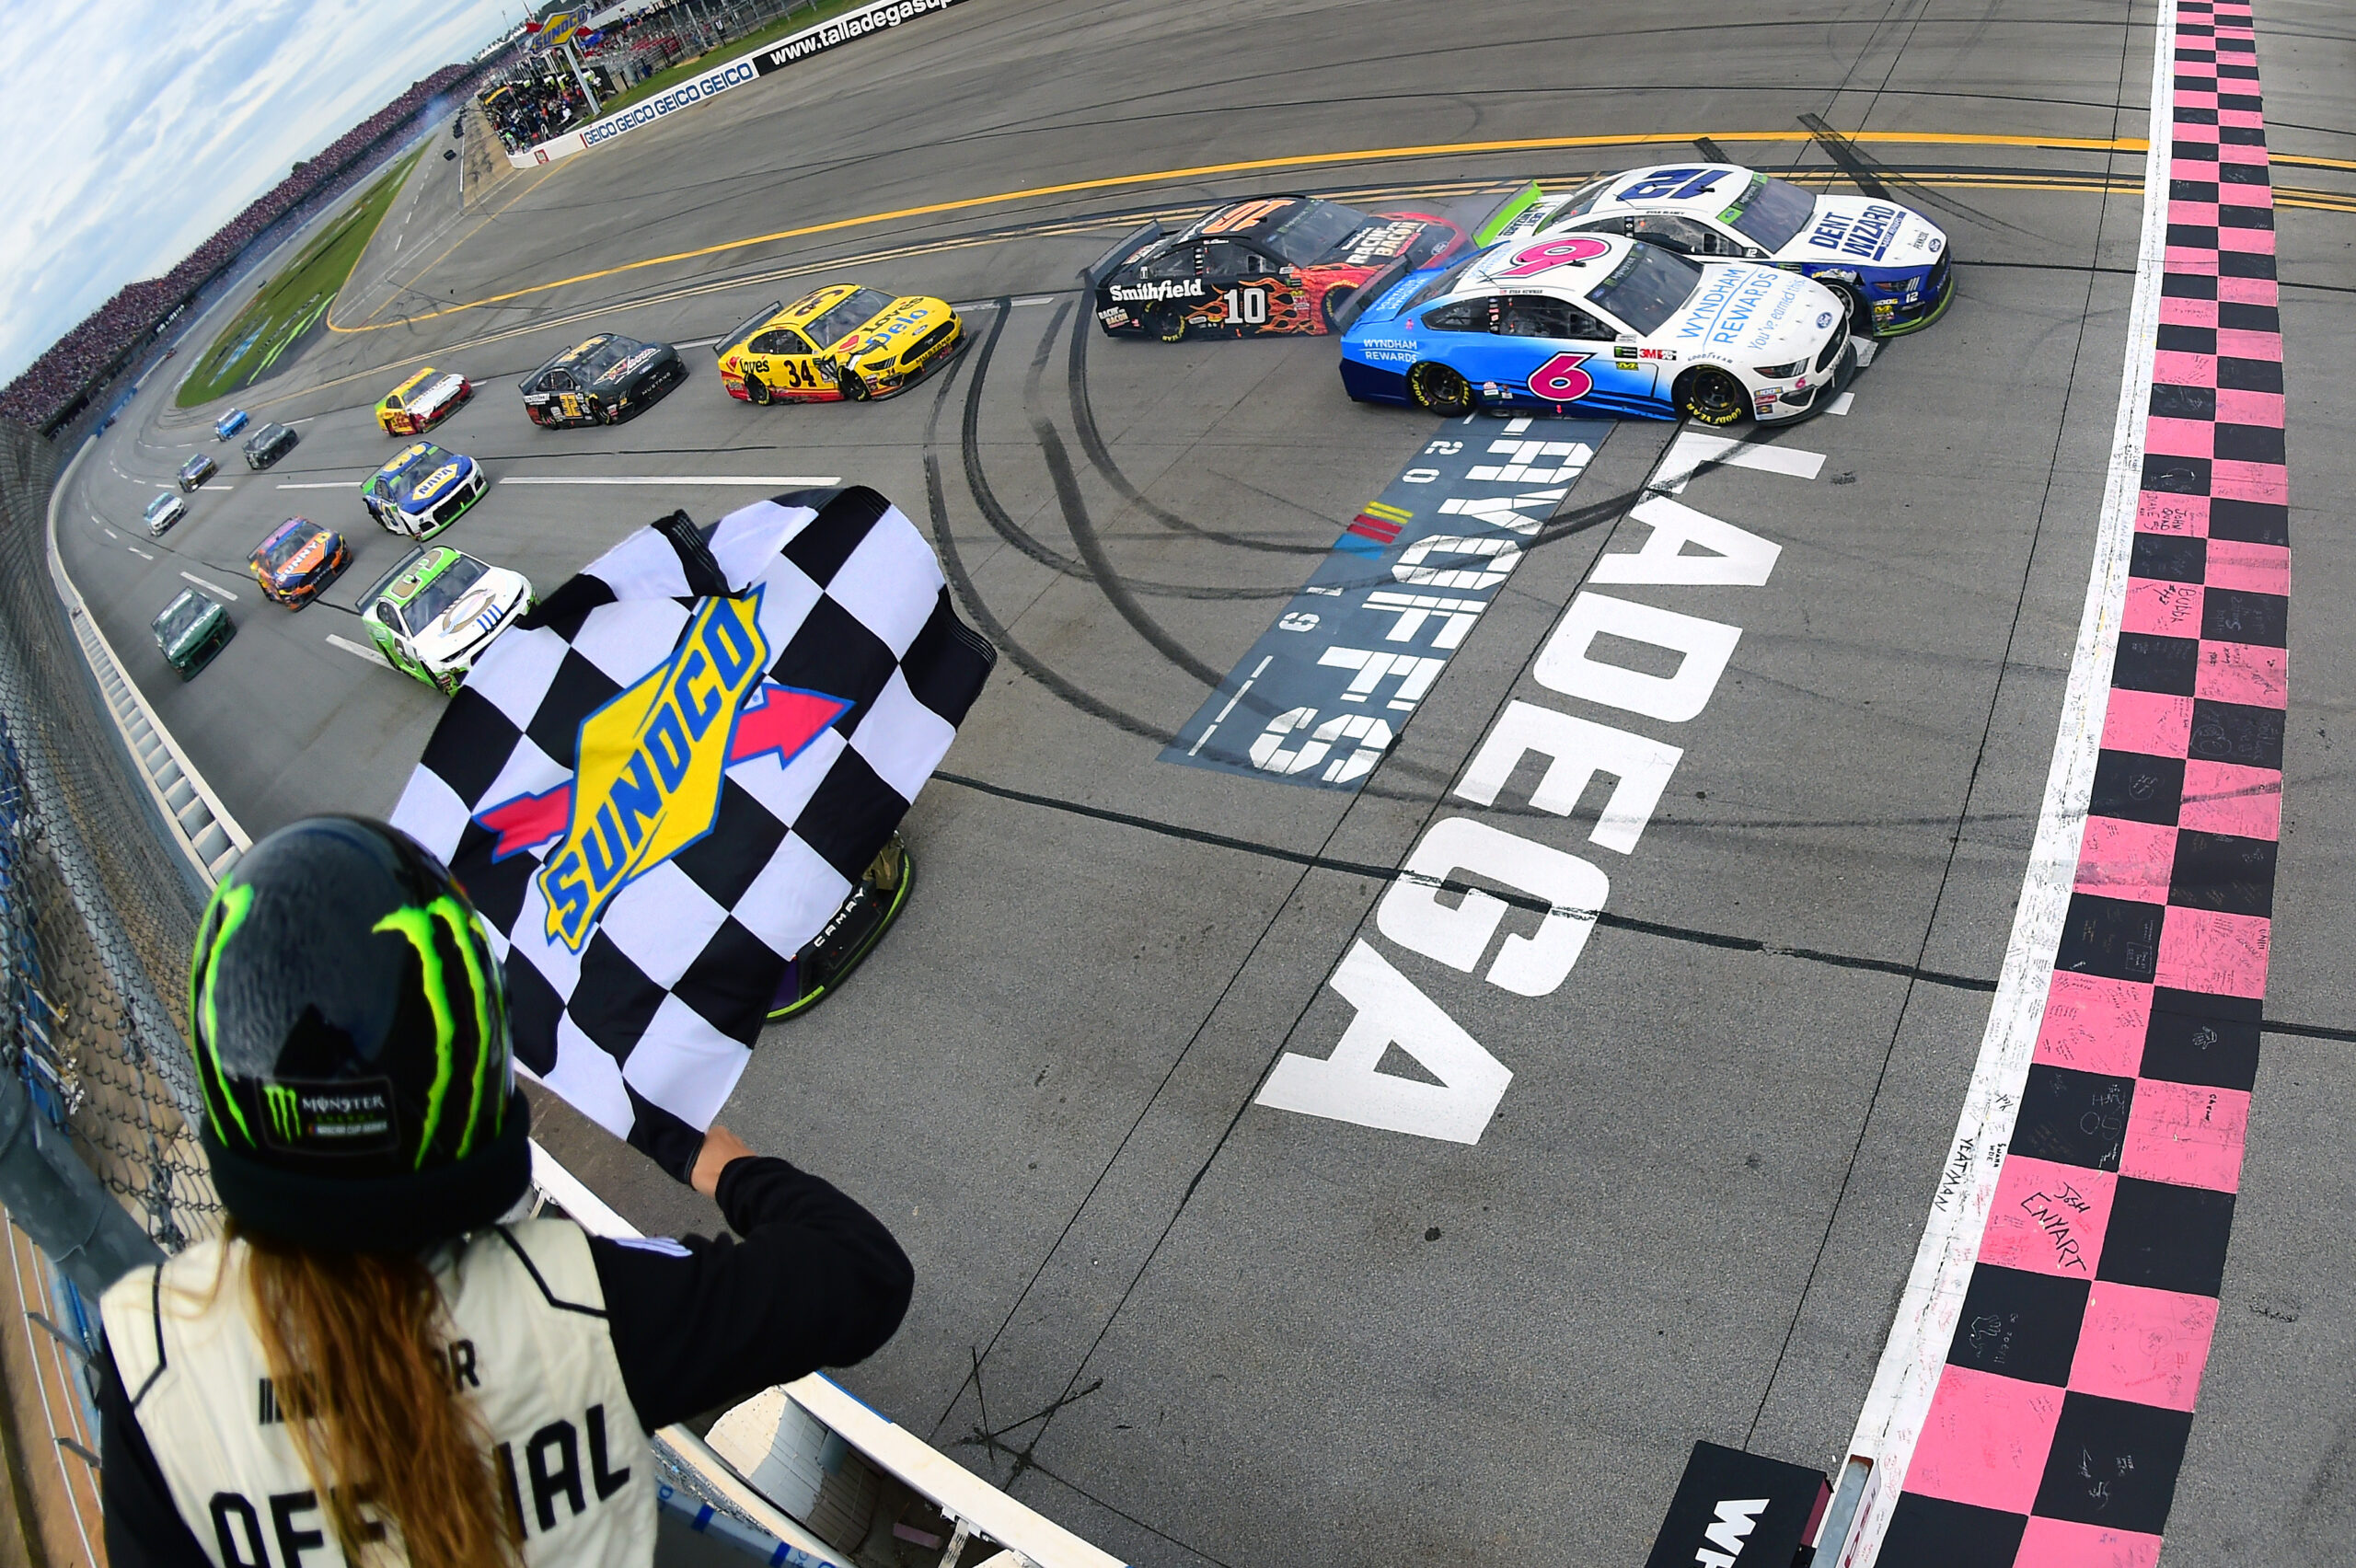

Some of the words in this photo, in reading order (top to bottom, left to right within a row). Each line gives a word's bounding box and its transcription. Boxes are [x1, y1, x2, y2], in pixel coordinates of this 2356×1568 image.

[536, 8, 587, 49] SUNOCO
[583, 121, 617, 145] GEICO
[617, 104, 656, 133] GEICO
[654, 85, 701, 115] GEICO
[700, 63, 754, 97] GEICO
[1374, 222, 1419, 257] BACON
[1808, 212, 1854, 249] DENT
[1842, 204, 1896, 258] WIZARD
[1110, 279, 1205, 302] Smithfield
[1224, 288, 1265, 324] 10
[1677, 268, 1747, 339] WYNDHAM
[1713, 271, 1779, 344] REWARDS
[1906, 291, 1919, 304] 12
[865, 309, 929, 345] Delo
[1363, 339, 1417, 351] WYNDHAM
[915, 336, 952, 365] MUSTANG
[1365, 352, 1417, 363] REWARDS
[1639, 349, 1657, 360] 3M
[1687, 352, 1733, 365] GOODYEAR
[641, 372, 672, 396] MUSTANG
[783, 359, 817, 387] 34
[1527, 351, 1598, 403] 6
[1686, 402, 1742, 425] GOODYEAR
[418, 467, 453, 495] NAPA
[278, 541, 318, 582] SUNNY
[1249, 417, 1594, 784] AYOFFS
[545, 596, 760, 920] SUNOCO
[1254, 393, 1854, 1145] LADEGA
[814, 886, 864, 948] CAMRY
[302, 1093, 385, 1113] MONSTER
[348, 1124, 362, 1135] CUP
[1934, 1137, 1974, 1213] YEATMAN
[2053, 1181, 2091, 1214] JOSH
[2020, 1192, 2087, 1273] ENYART
